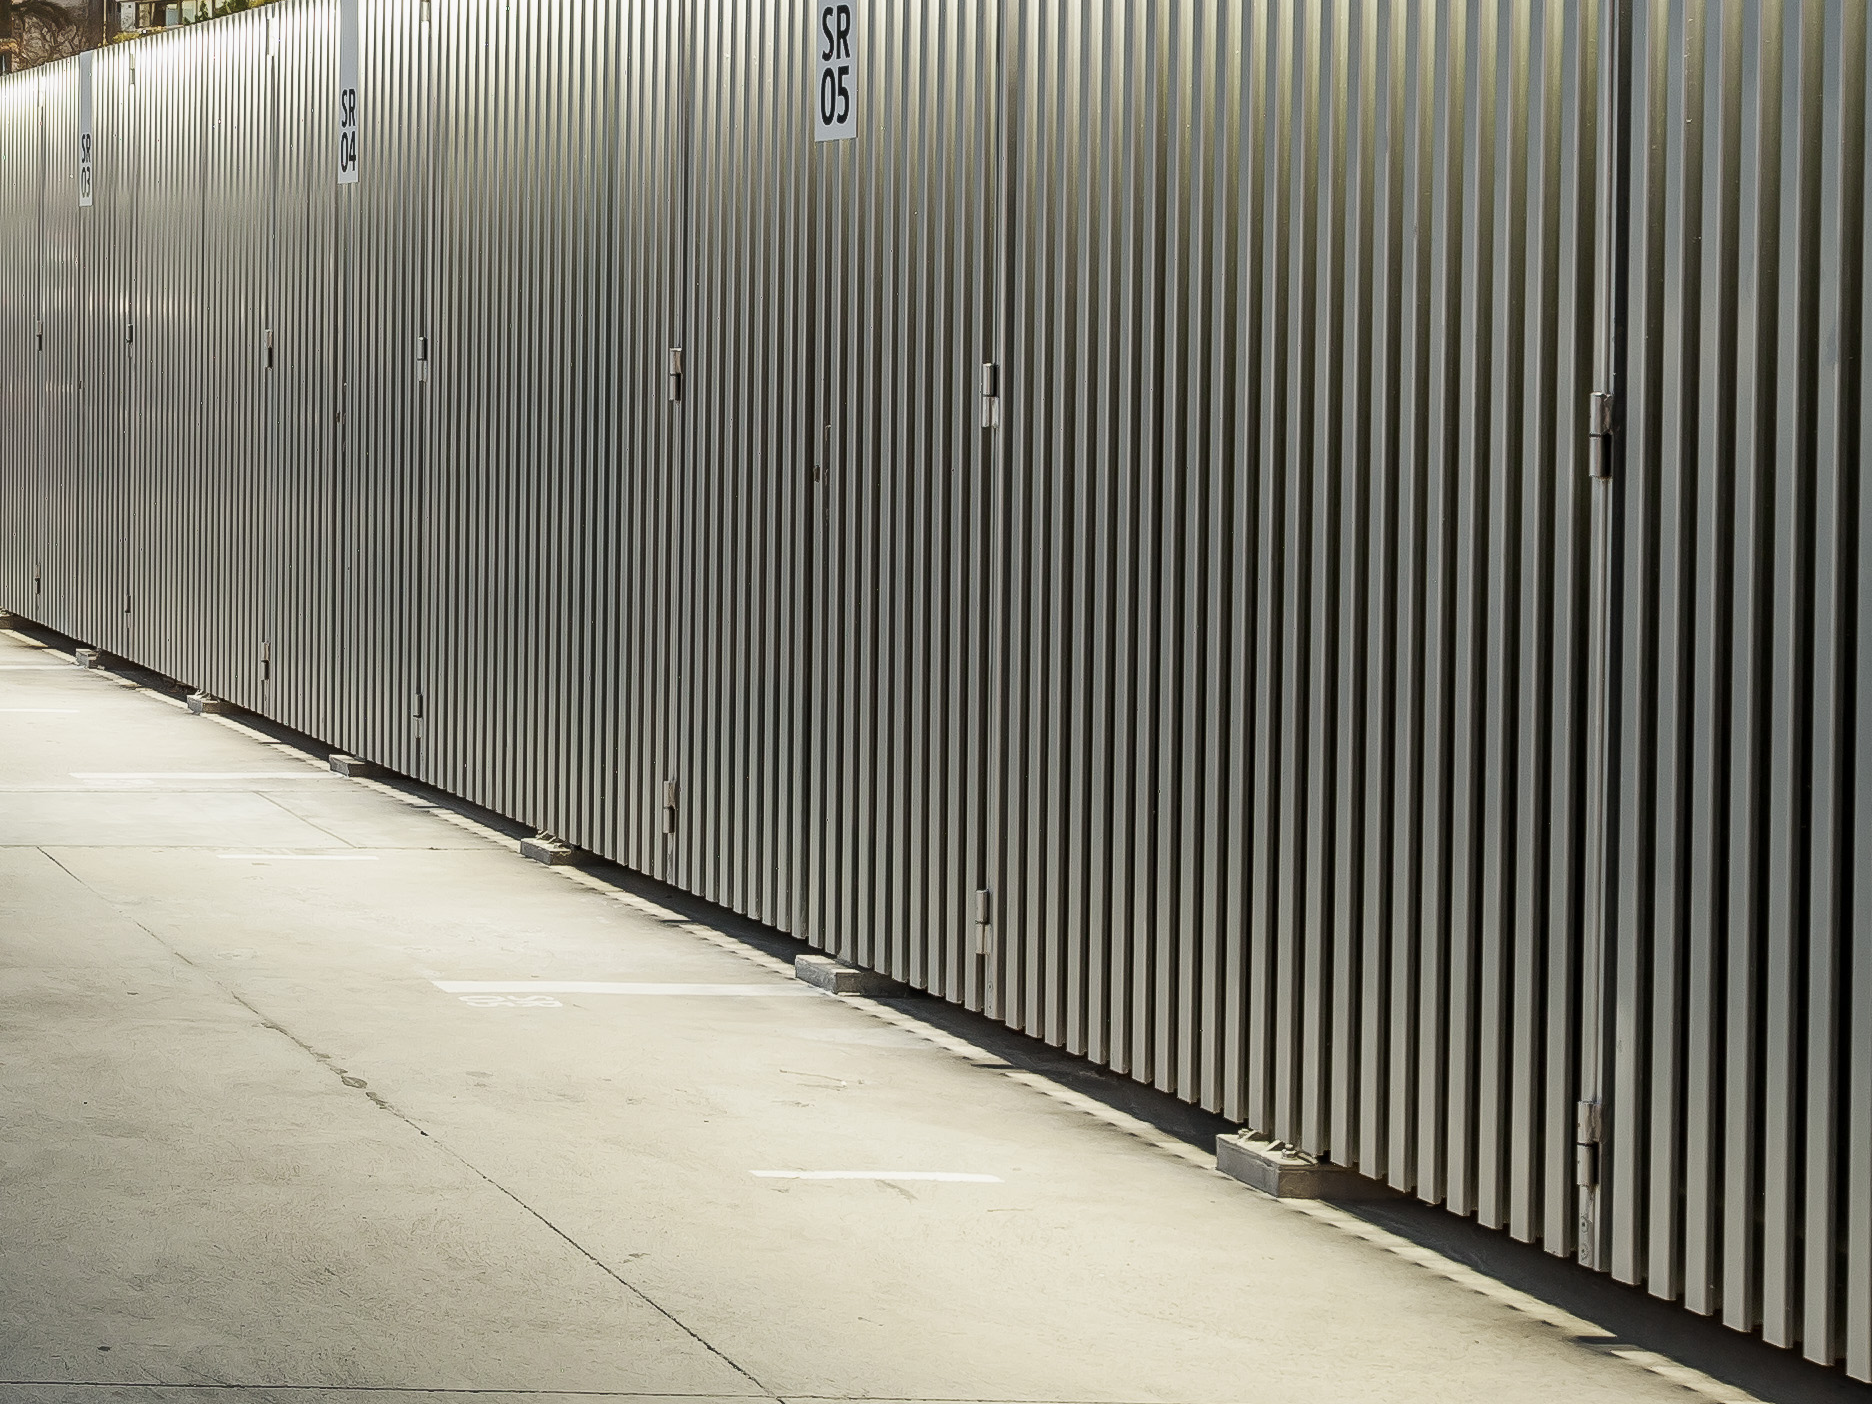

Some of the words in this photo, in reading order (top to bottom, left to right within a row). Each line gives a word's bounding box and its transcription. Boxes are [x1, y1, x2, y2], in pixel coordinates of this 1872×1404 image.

[821, 4, 851, 62] SR
[341, 88, 356, 128] SR
[820, 65, 850, 126] 05
[81, 133, 91, 164] SR
[340, 130, 357, 173] 04
[81, 166, 91, 198] 03
